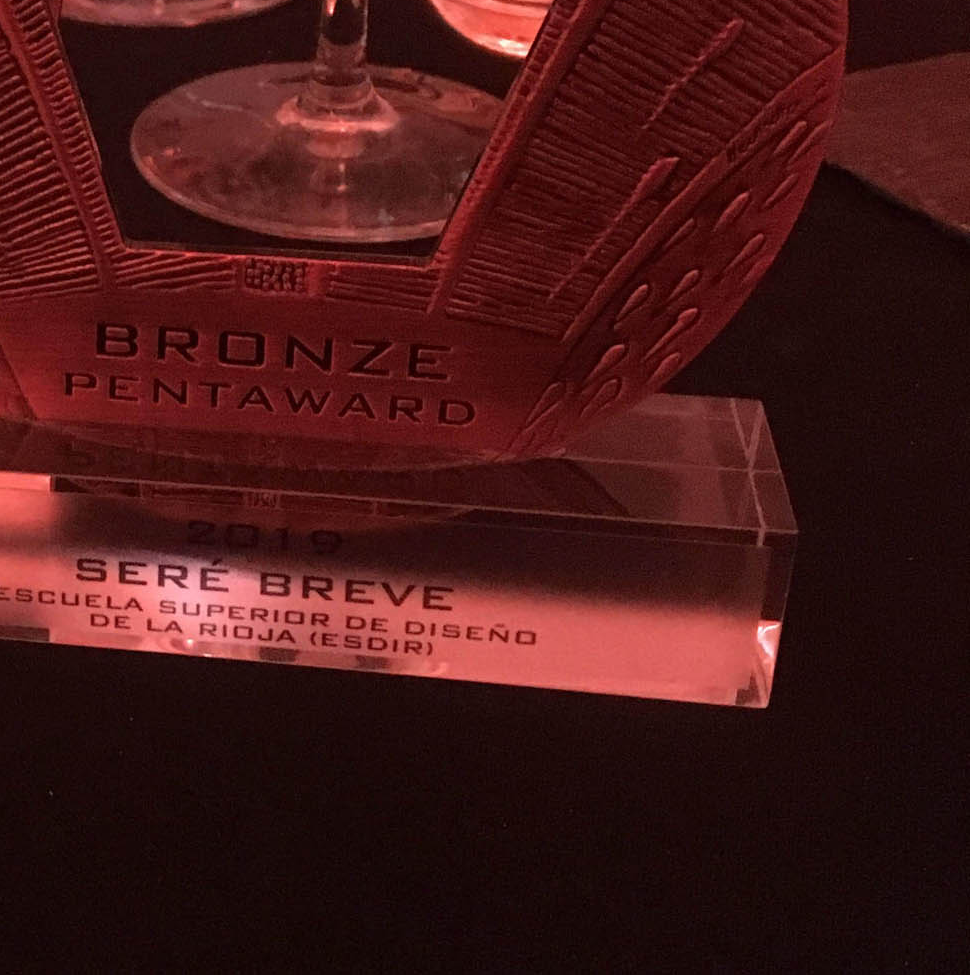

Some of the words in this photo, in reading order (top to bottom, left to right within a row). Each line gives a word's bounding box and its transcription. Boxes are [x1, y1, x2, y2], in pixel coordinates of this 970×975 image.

[96, 322, 453, 381] BRONZE
[63, 371, 477, 427] PENTAWARD
[186, 519, 344, 556] 2019
[76, 558, 230, 594] SERÉ
[259, 572, 454, 612] BREVE
[89, 613, 131, 631] DE
[146, 617, 184, 635] LA
[198, 622, 297, 645] RIOJA
[309, 631, 434, 657] (ESDIR)
[159, 599, 331, 627] SUPERIOR
[345, 615, 389, 634] DE
[404, 619, 537, 647] DISEÑO
